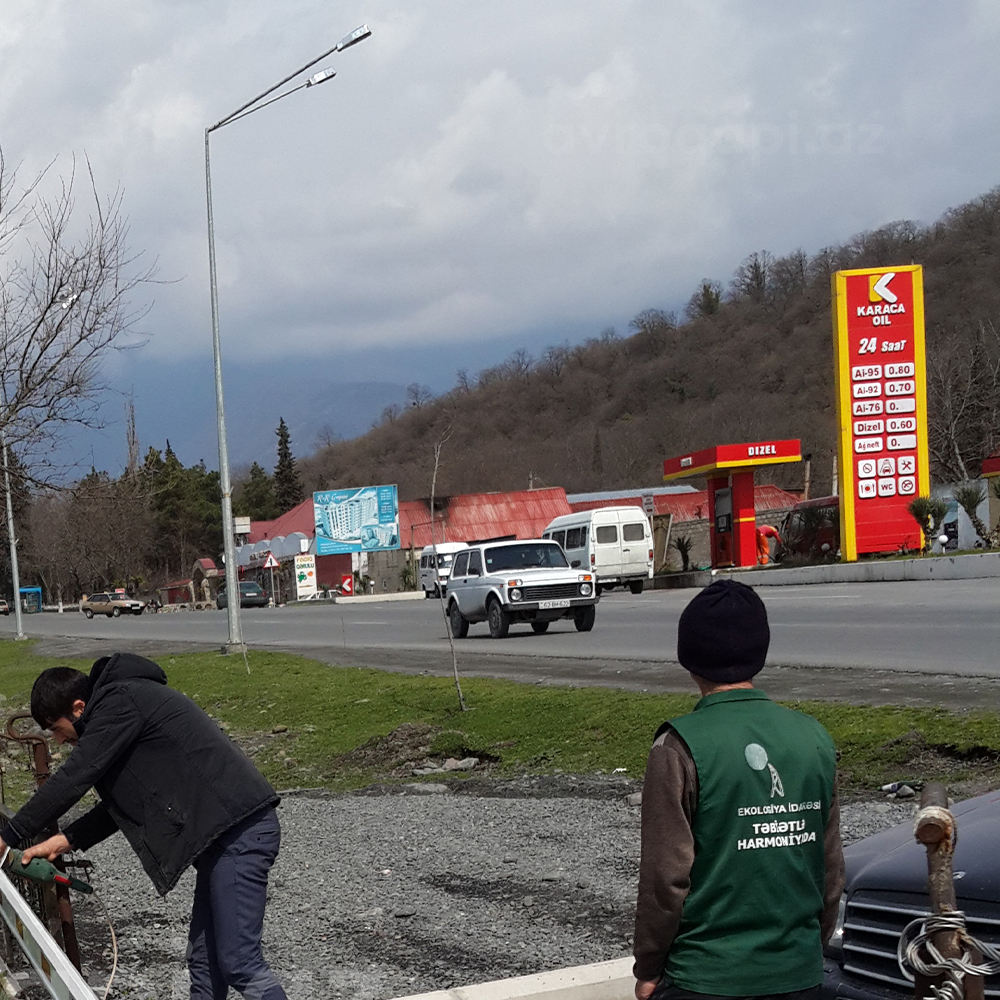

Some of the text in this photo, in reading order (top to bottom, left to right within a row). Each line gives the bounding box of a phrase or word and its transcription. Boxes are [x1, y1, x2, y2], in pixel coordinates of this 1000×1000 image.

[857, 304, 905, 316] KARACA
[872, 315, 891, 326] OIL
[858, 337, 877, 354] 24
[855, 365, 910, 378] Ai-95 0.80
[857, 383, 911, 395] Ai-92 0.70
[856, 402, 899, 413] Ai-76 0.
[857, 420, 912, 432] Dizel 0.60
[891, 438, 900, 446] 0.
[748, 445, 776, 456] DIZEL
